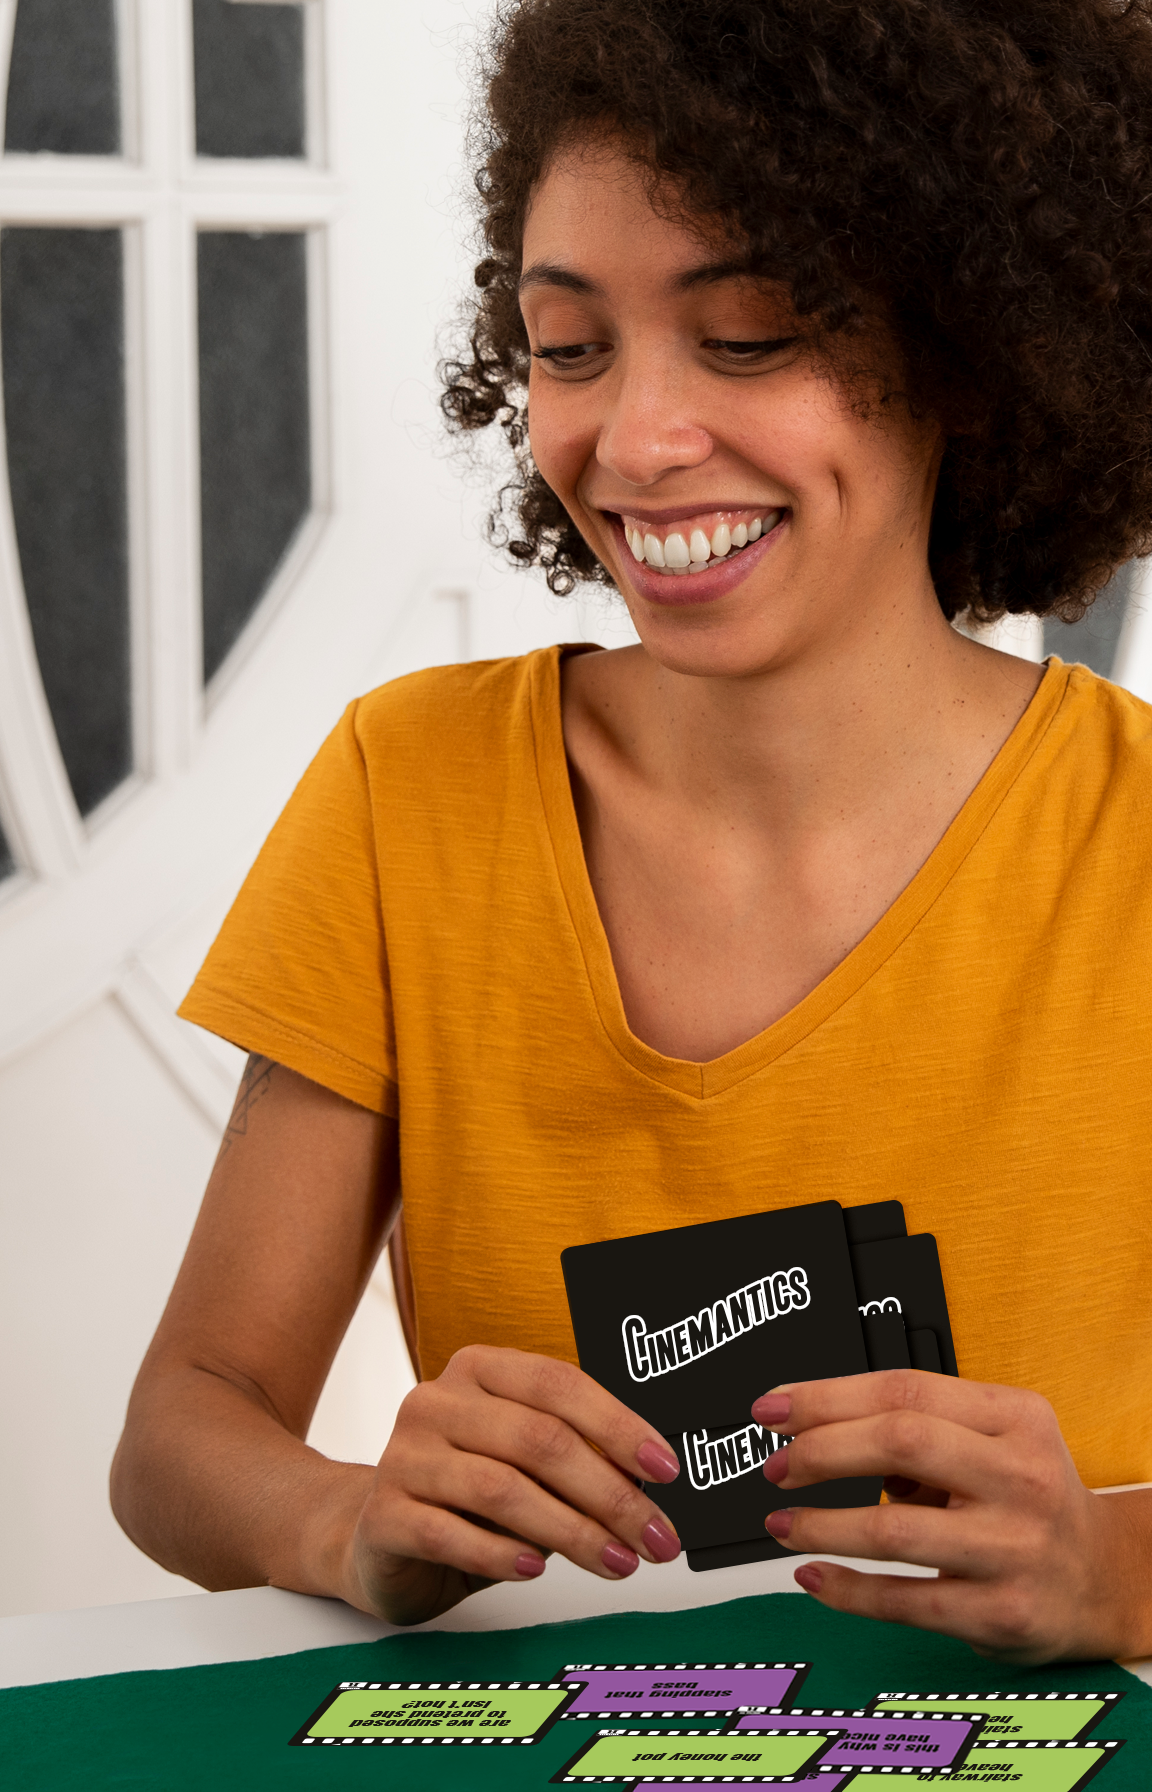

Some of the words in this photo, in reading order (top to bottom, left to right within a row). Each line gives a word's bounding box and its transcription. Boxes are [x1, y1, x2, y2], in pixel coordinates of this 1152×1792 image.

[622, 1267, 811, 1382] CINEMANTICS
[651, 1681, 699, 1690] bass
[604, 1690, 645, 1699] that
[649, 1689, 733, 1699] slapping
[402, 1700, 446, 1709] hot?
[370, 1710, 405, 1719] she
[406, 1710, 485, 1720] pretend
[487, 1710, 507, 1719] to
[348, 1718, 443, 1728] supposed
[445, 1719, 473, 1727] we
[478, 1719, 512, 1727] are
[884, 1733, 931, 1743] have
[837, 1741, 878, 1752] why
[882, 1743, 901, 1753] is
[903, 1743, 941, 1754] this
[631, 1752, 667, 1762] pot
[667, 1752, 729, 1762] honey
[730, 1753, 763, 1762] the
[916, 1773, 938, 1782] to
